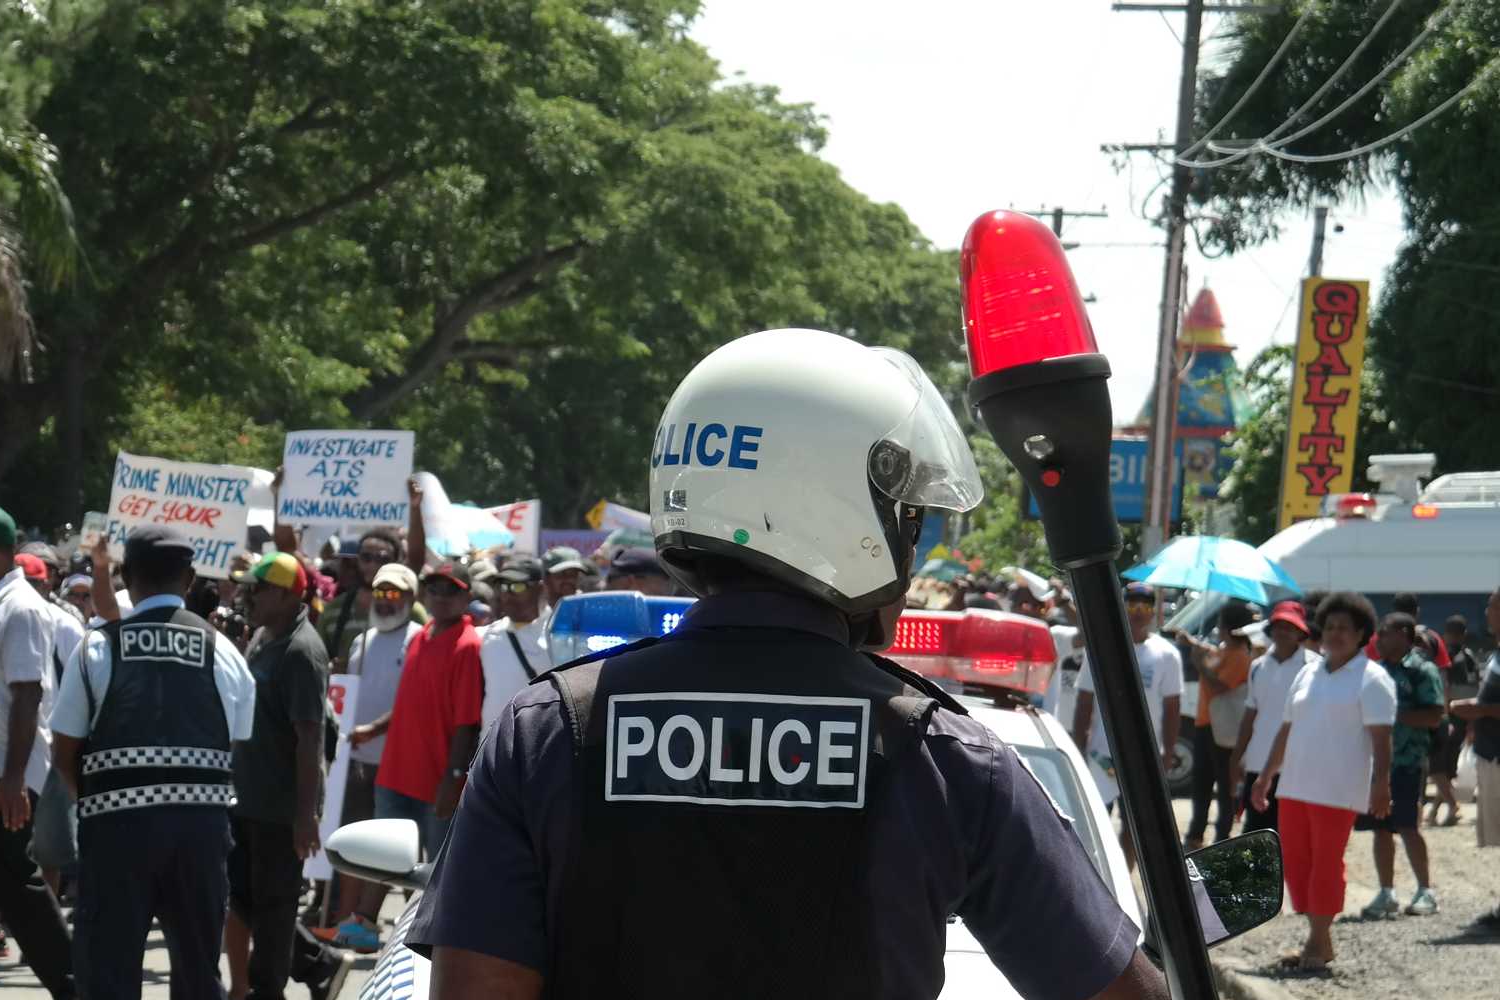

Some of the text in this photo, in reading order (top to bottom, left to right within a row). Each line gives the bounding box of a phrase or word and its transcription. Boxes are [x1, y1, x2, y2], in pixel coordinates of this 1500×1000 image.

[1297, 281, 1360, 496] QUALITY
[289, 436, 398, 458] INVESTIGATE
[652, 423, 763, 470] OLICE
[115, 458, 250, 506] PRIME MINISTER
[307, 459, 366, 478] ATS
[320, 480, 360, 497] FOR
[118, 494, 222, 529] GET YOUR
[280, 498, 408, 520] MISMANAGEMENT
[123, 629, 201, 658] POLICE
[617, 714, 857, 786] POLICE
